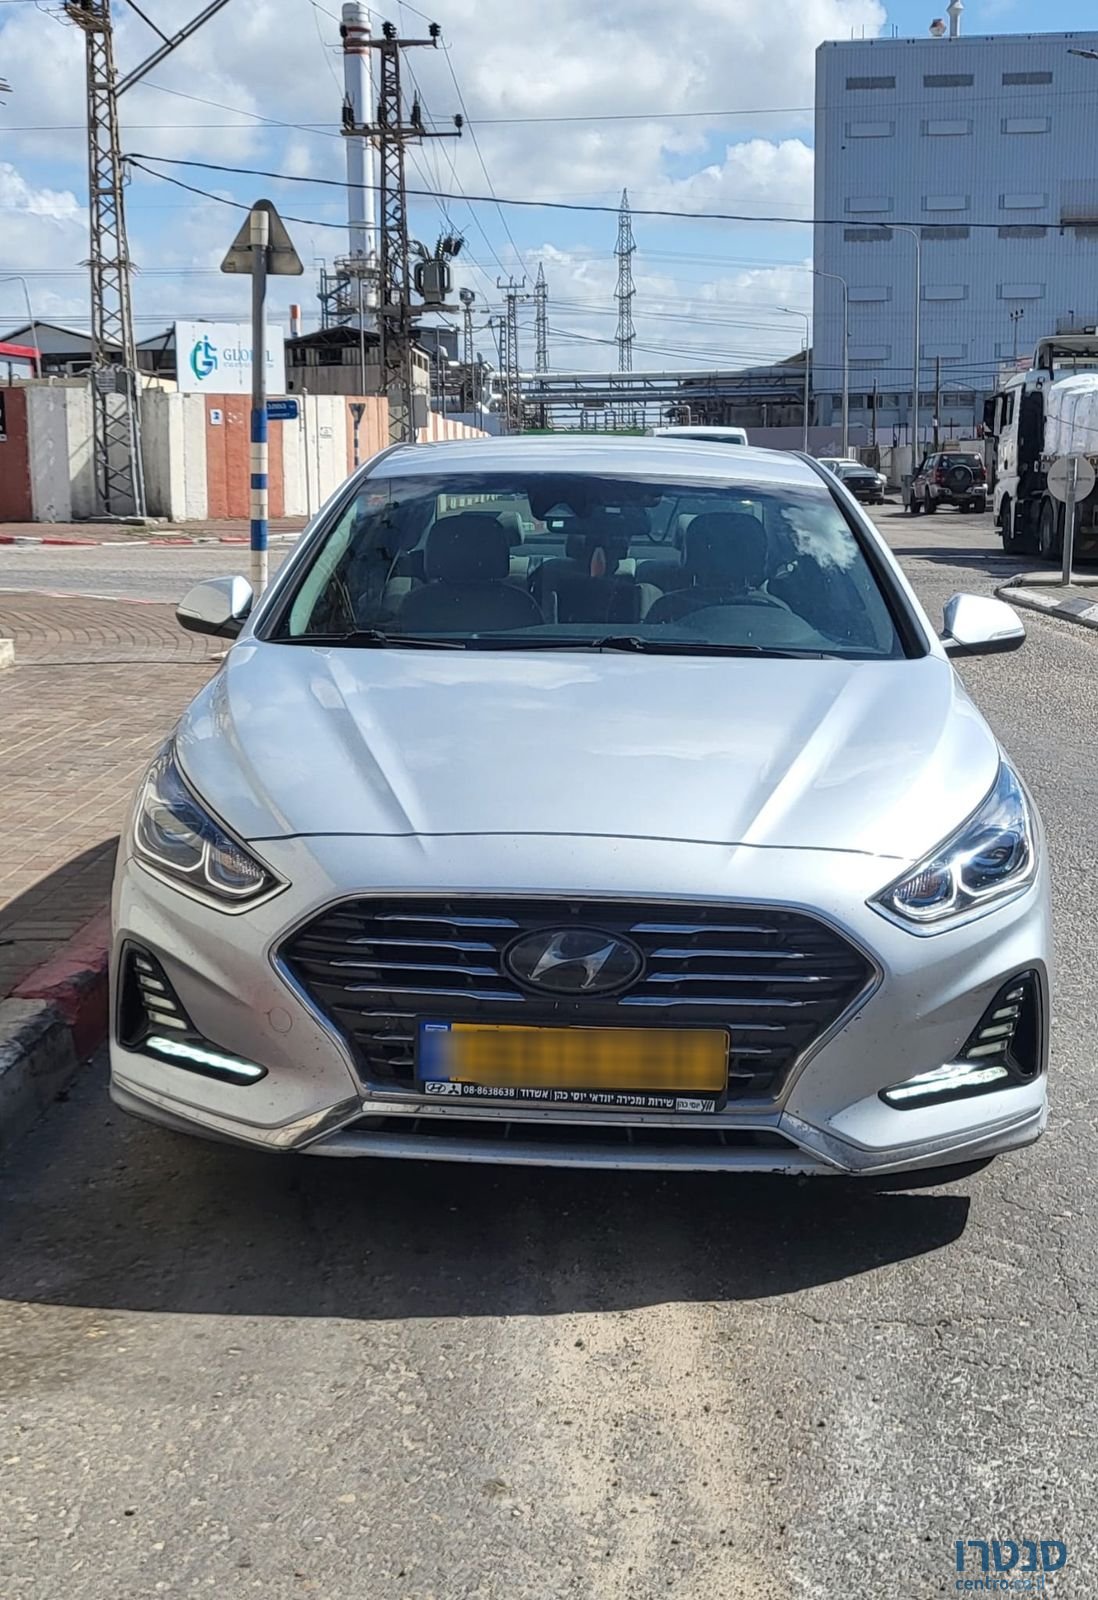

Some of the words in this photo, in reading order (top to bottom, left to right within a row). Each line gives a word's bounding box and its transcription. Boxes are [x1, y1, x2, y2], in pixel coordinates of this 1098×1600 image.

[463, 1085, 515, 1097] 08-8638638
[520, 1088, 548, 1099] אשדוד
[554, 1090, 568, 1102] כהן
[570, 1091, 587, 1101] יוסי
[589, 1092, 614, 1104] יונדאי
[616, 1095, 646, 1106] ומכירה
[648, 1096, 674, 1108] שירות
